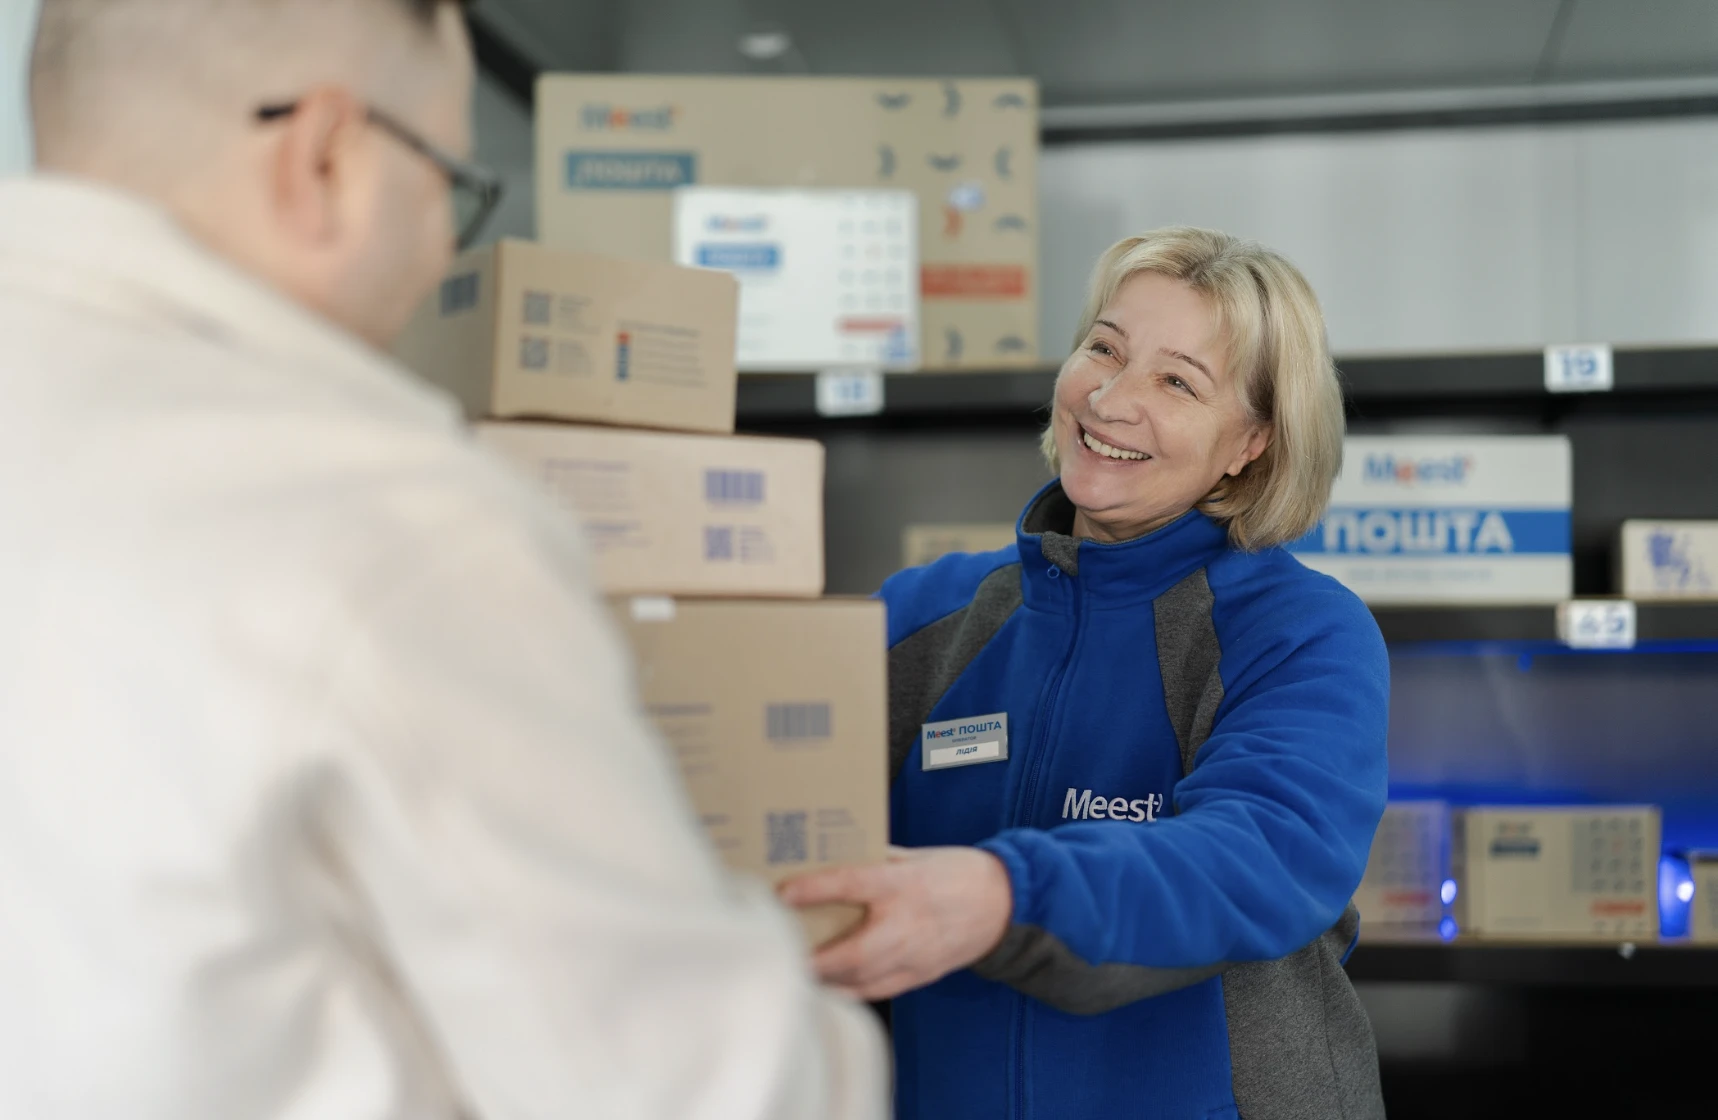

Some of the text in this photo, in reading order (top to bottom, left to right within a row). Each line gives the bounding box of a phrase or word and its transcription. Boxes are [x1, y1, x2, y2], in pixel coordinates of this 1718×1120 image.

[1560, 349, 1598, 382] 19
[1325, 510, 1514, 554] ПОШТА
[926, 720, 1002, 740] Meest ПОШТА
[956, 746, 978, 756] ЛІДІЯ
[1062, 787, 1164, 823] Meest
